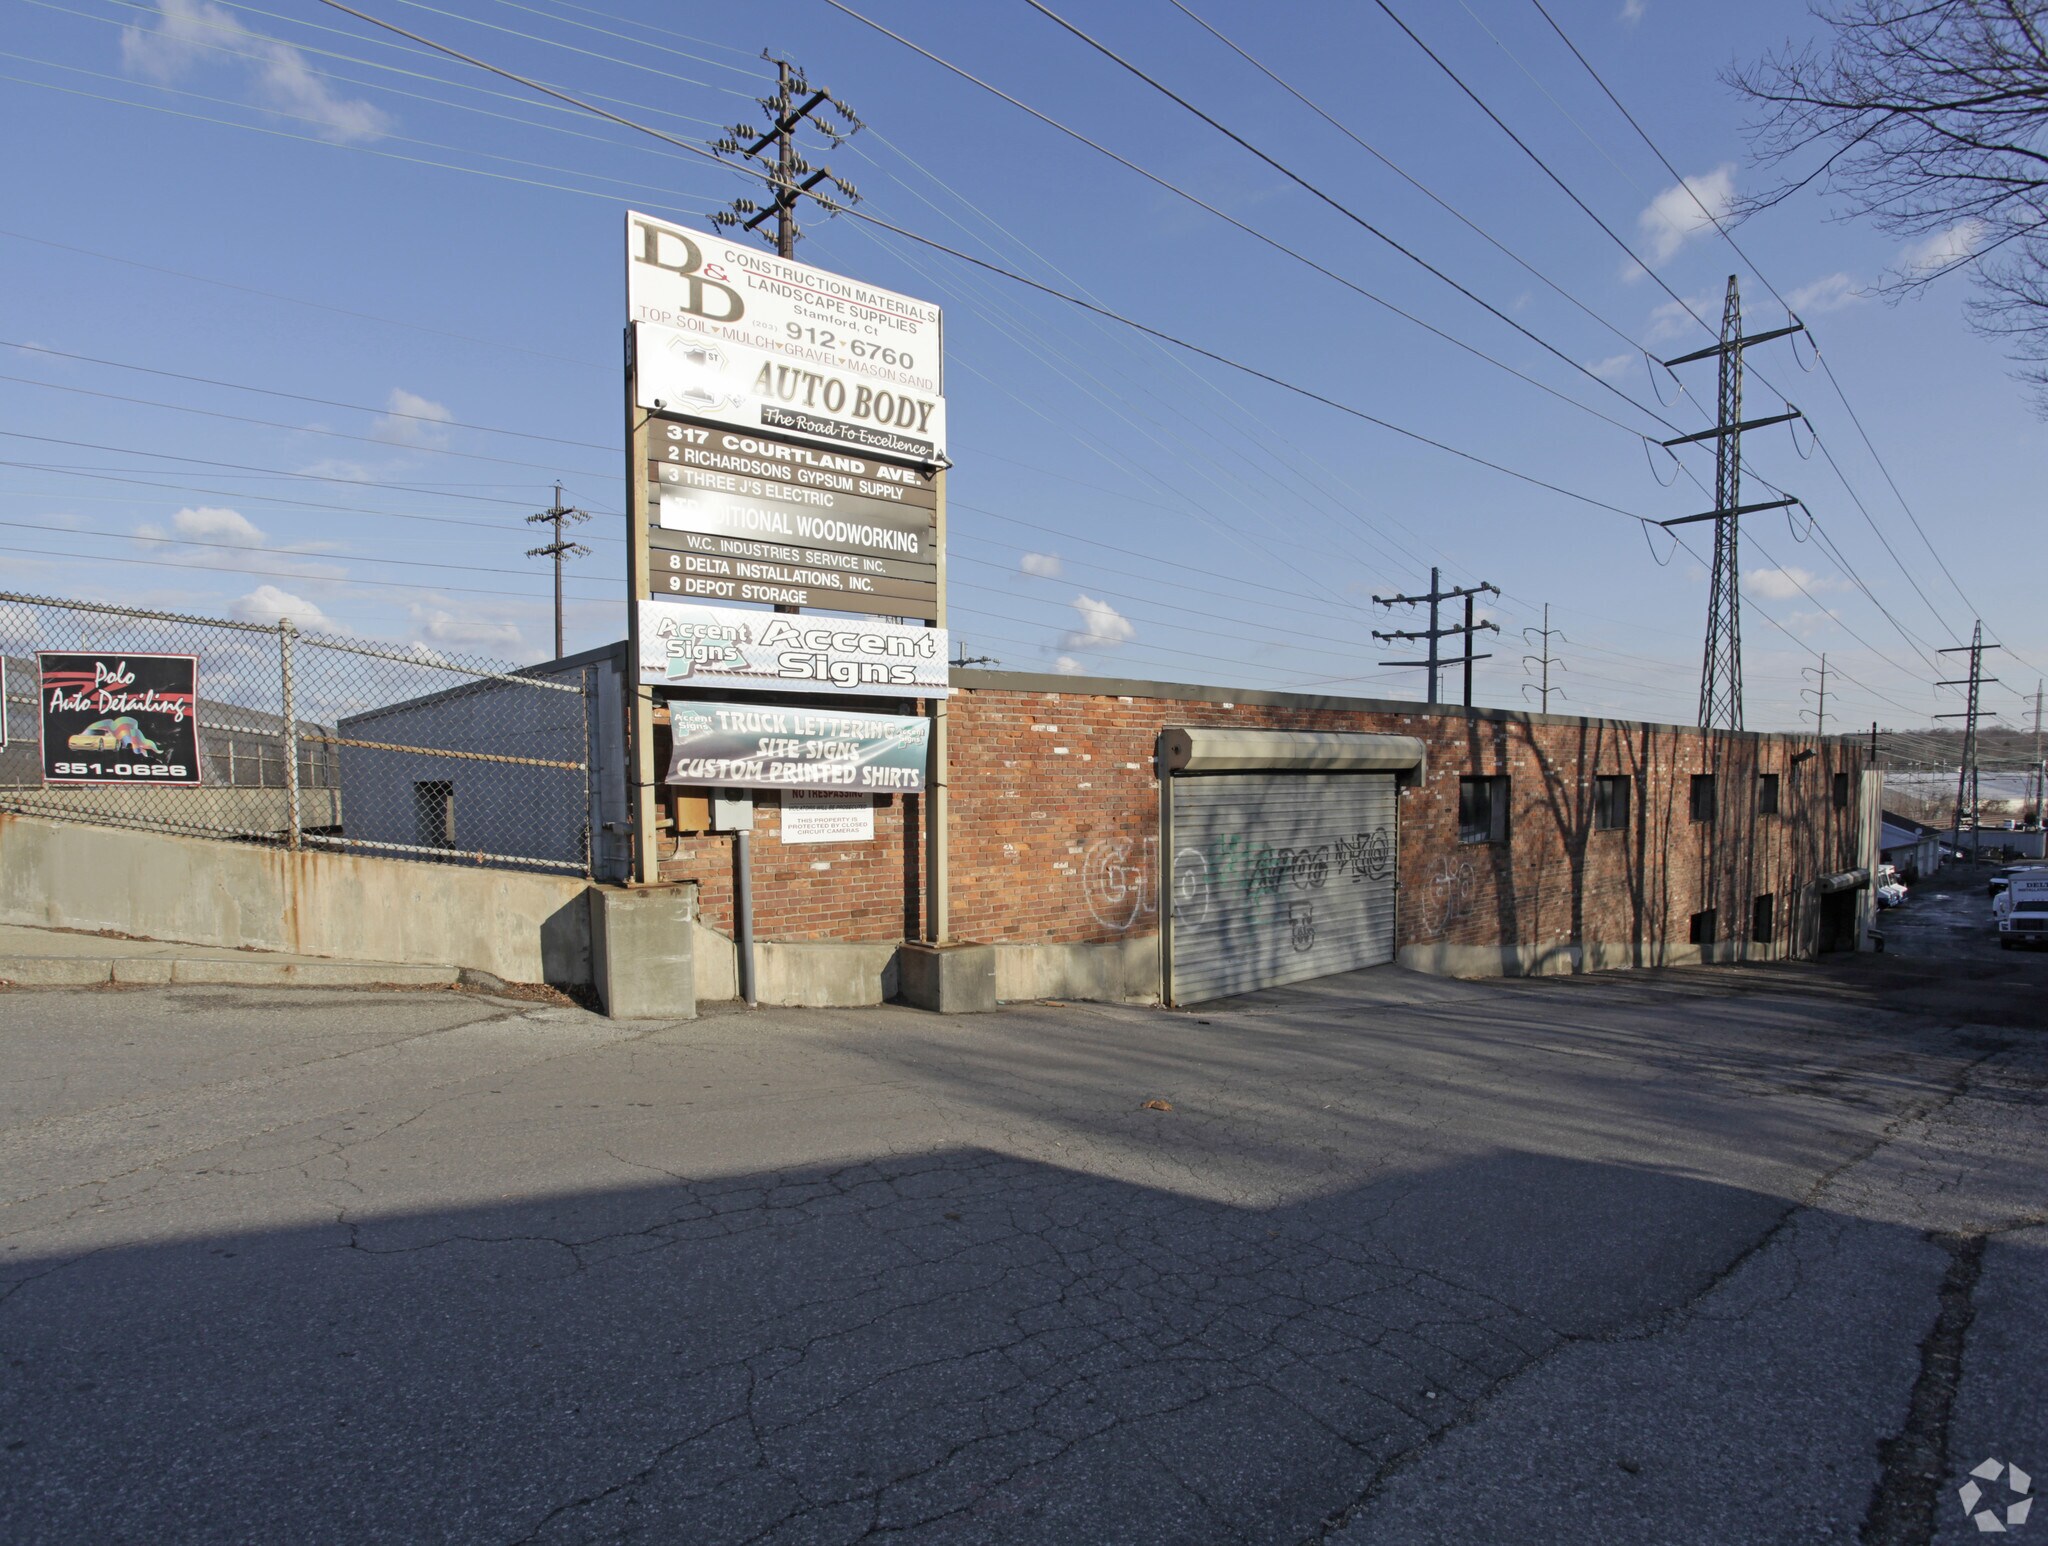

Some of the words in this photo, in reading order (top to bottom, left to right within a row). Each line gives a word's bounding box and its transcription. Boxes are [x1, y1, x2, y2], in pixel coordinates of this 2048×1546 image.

[724, 250, 851, 298] CONSTRUCTION
[856, 289, 936, 323] MATERIALS
[748, 275, 845, 314] LANDSCAPE
[849, 305, 917, 334] SUPPLIES
[793, 304, 860, 332] Stamford,
[864, 324, 878, 336] Ct
[752, 319, 778, 332] (203)
[640, 305, 671, 323] TOP
[676, 315, 711, 334] SOIL
[722, 326, 775, 350] MULCH
[784, 342, 839, 366] GRAVEL
[848, 358, 896, 381] MASON
[899, 372, 933, 390] SAND
[753, 360, 846, 414] AUTO
[851, 384, 935, 434] BODY
[765, 408, 793, 427] The
[666, 424, 709, 445] 317
[722, 435, 865, 474] COURTLAND
[876, 466, 921, 485] AVE.
[668, 445, 679, 460] 2
[684, 448, 791, 480] RICHARDSONS
[797, 469, 853, 491] GYPSUM
[859, 480, 904, 500] SUPPLY
[668, 467, 679, 482] 3
[684, 469, 736, 491] THREE
[740, 480, 762, 495] J'S
[765, 483, 834, 507] ELECTRIC
[796, 515, 918, 553] WOODWORKING
[720, 540, 800, 562] INDUSTRIES
[805, 551, 859, 570] SERVICE
[863, 558, 886, 573] INC.
[669, 555, 681, 569] 8
[685, 556, 730, 575] DELTA
[736, 562, 843, 590] INSTALLATIONS,
[849, 576, 874, 592] INC.
[669, 576, 681, 591] 9
[685, 578, 735, 597] DEPOT
[741, 584, 808, 604] STORAGE
[656, 617, 747, 641] Accent
[758, 619, 936, 659] Accent
[666, 639, 738, 664] Signs
[95, 660, 136, 688] Polo
[778, 651, 917, 688] Signs
[49, 687, 91, 714] Auto
[98, 688, 186, 722] Detailing
[674, 714, 712, 722] Accent
[715, 710, 788, 734] TRUCK
[794, 715, 896, 740] LETTERING
[756, 737, 800, 759] SITE
[806, 740, 860, 761] SIGNS
[54, 762, 188, 777] 351-0626
[676, 758, 763, 780] CUSTOM
[769, 762, 857, 784] PRINTED
[862, 765, 920, 788] SHIRTS
